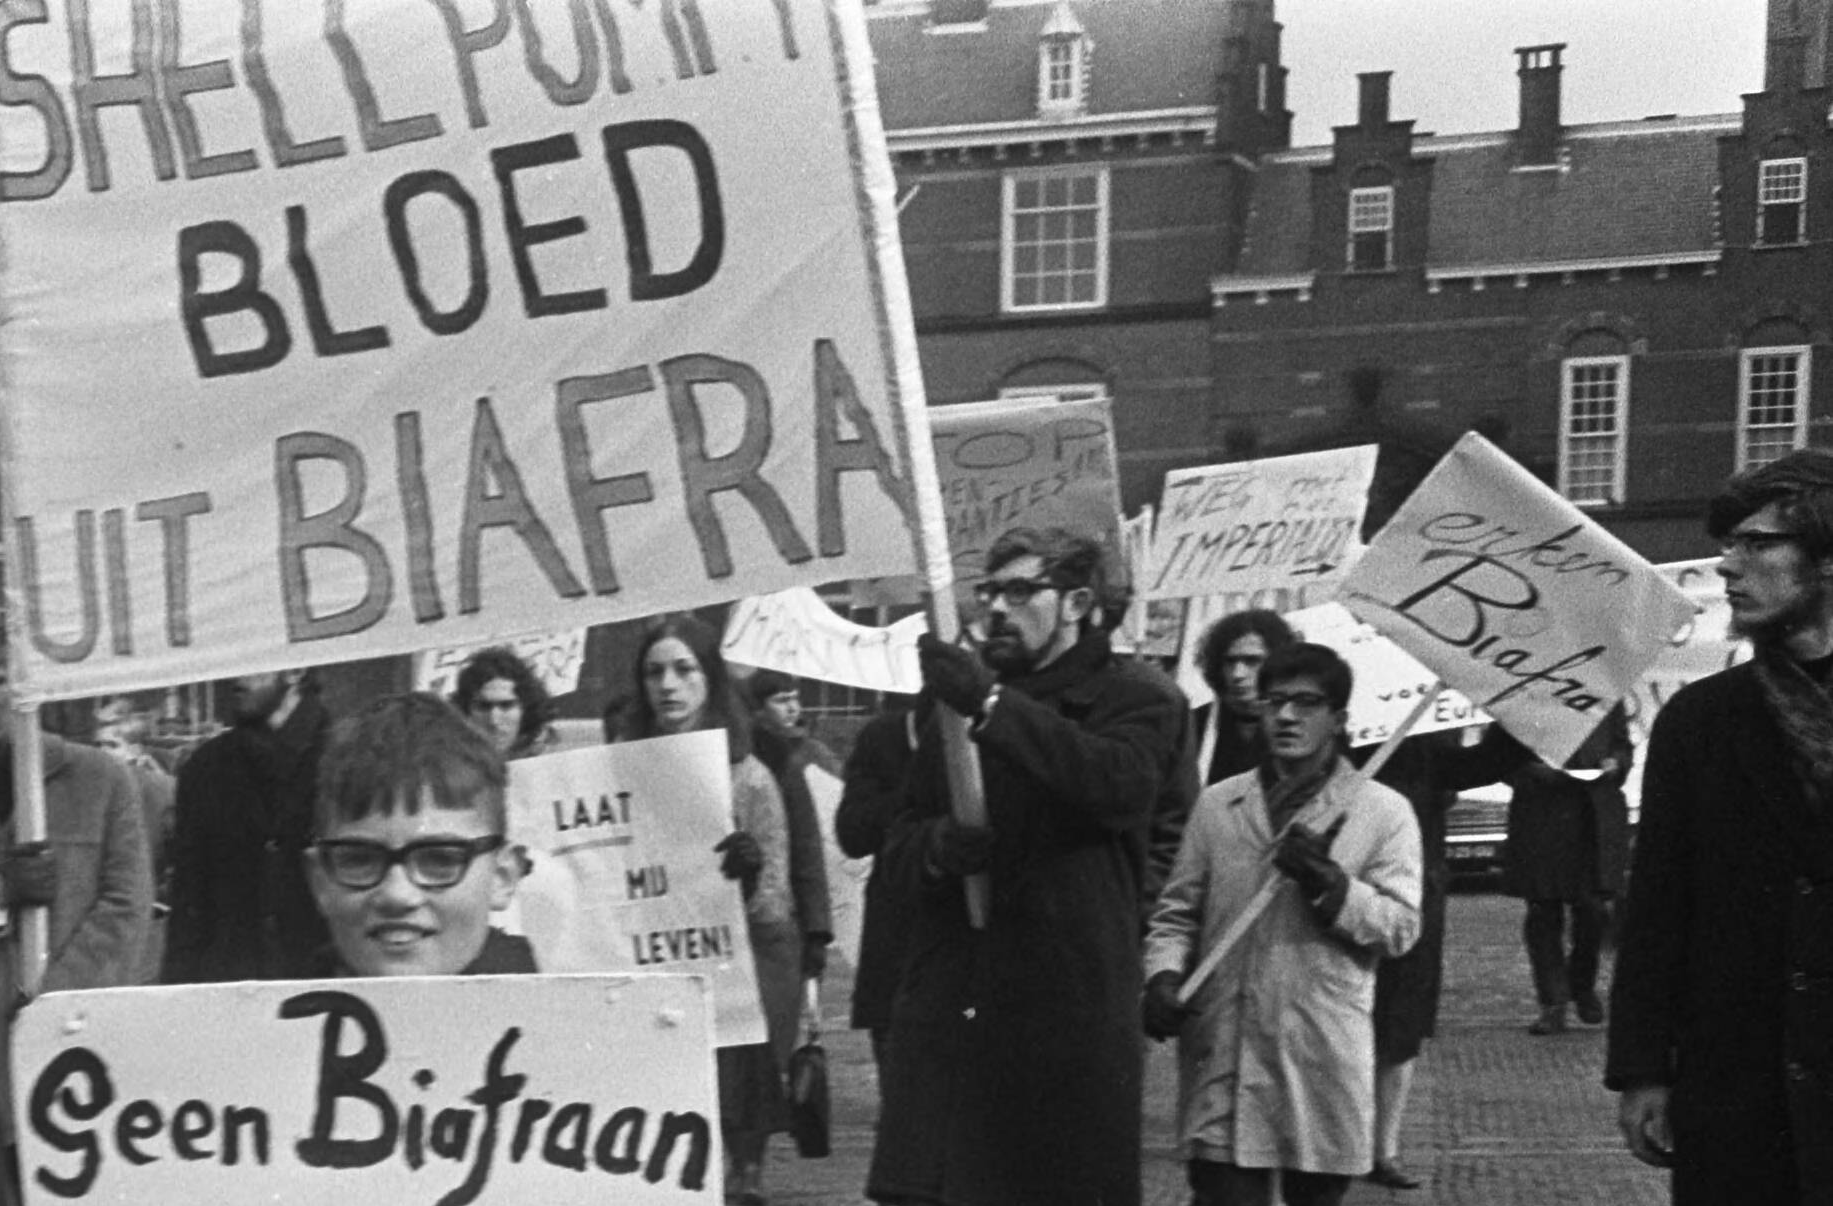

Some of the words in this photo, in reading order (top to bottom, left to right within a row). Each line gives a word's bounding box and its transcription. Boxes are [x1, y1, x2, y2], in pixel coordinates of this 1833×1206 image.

[178, 119, 725, 377] BLOED
[16, 492, 211, 664] UIT
[274, 339, 918, 643] BIAFRA
[1418, 512, 1630, 586] erken
[1352, 547, 1607, 712] Biafra
[553, 791, 632, 831] LAAT
[633, 925, 733, 965] LEVEN!
[30, 1046, 270, 1198] Geen
